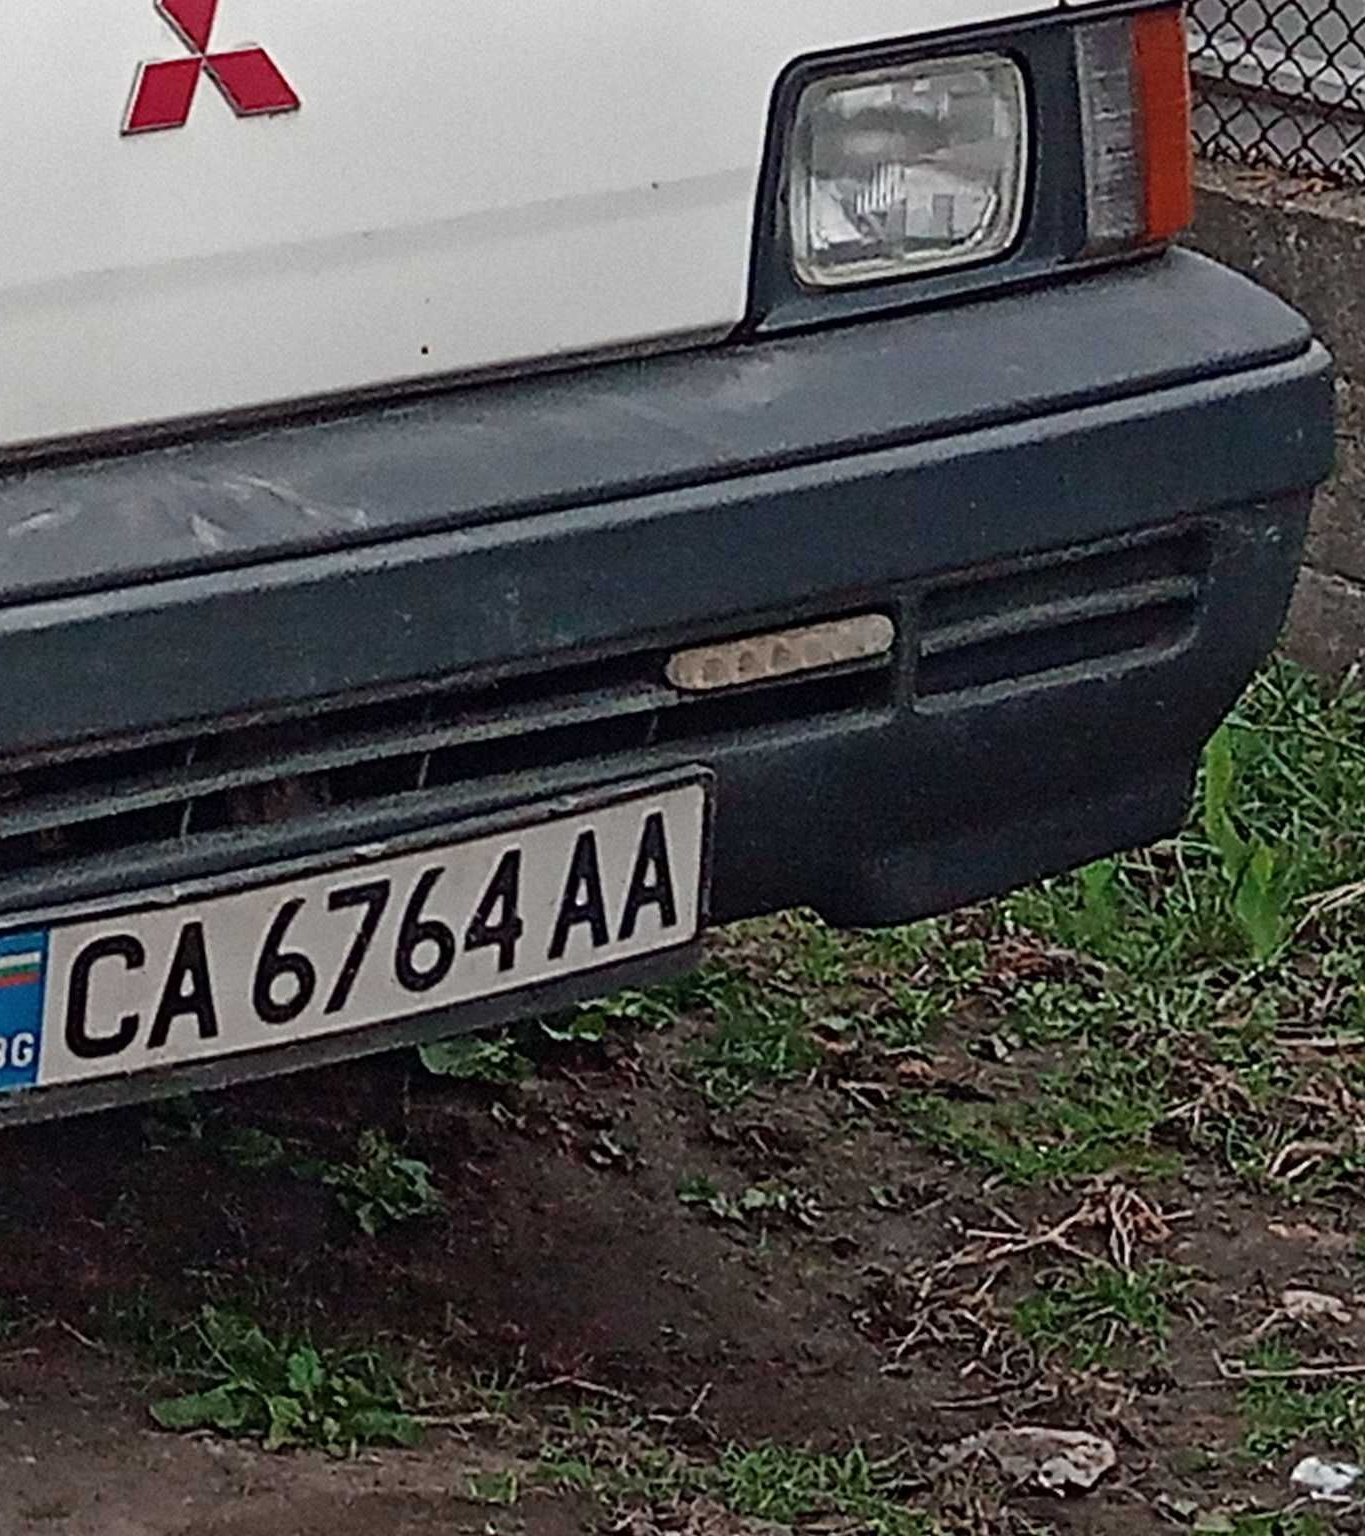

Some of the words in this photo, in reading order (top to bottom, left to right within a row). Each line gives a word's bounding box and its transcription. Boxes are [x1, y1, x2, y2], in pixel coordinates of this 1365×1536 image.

[65, 919, 220, 1060] CA
[252, 848, 523, 1026] 6764
[547, 810, 678, 961] AA
